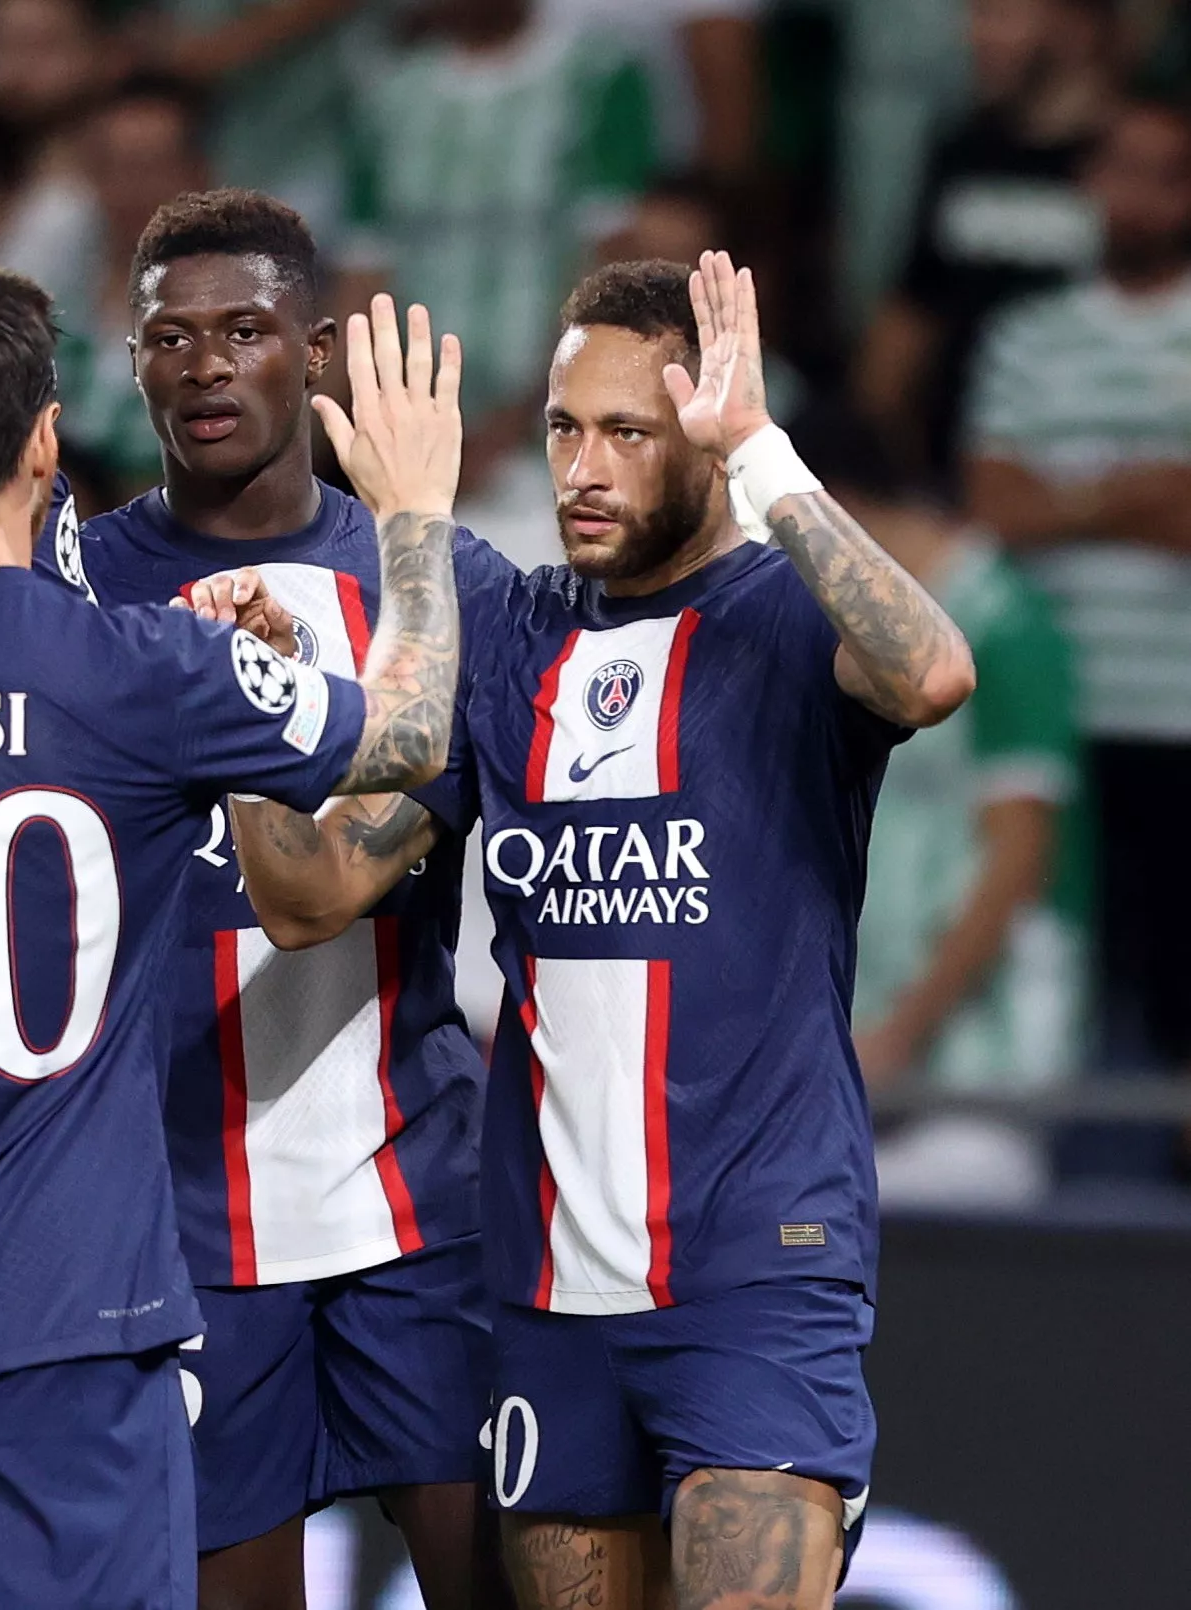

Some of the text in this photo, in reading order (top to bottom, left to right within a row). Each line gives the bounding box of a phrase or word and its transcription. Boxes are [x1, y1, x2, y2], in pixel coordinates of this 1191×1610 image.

[596, 664, 638, 684] PARIS
[485, 818, 711, 898] QATAR
[536, 885, 710, 925] AIRWAYS
